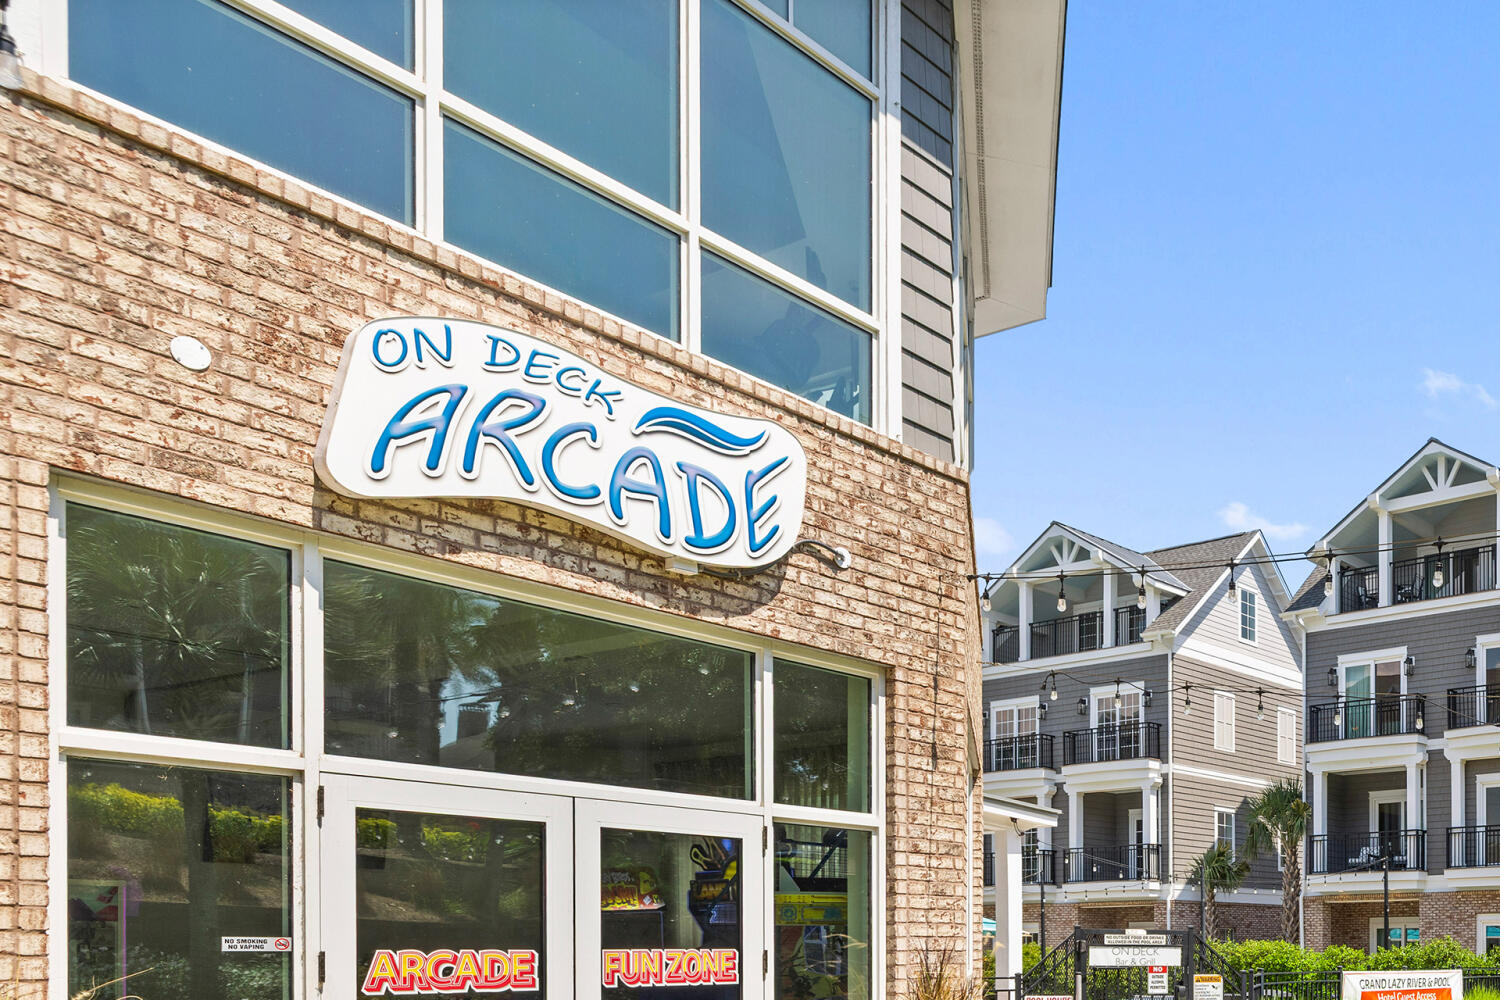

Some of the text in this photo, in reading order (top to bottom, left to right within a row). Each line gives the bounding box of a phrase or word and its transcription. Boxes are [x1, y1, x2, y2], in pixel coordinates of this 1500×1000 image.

[371, 324, 622, 418] ON DECK
[368, 383, 790, 554] ARCADE
[602, 949, 739, 989] FUN ZONE
[1111, 946, 1160, 956] ON DECK
[1115, 957, 1156, 966] Bar & Grill
[361, 949, 540, 995] ARCADE
[1359, 976, 1451, 990] GRAND LAZY RIVER & POOL
